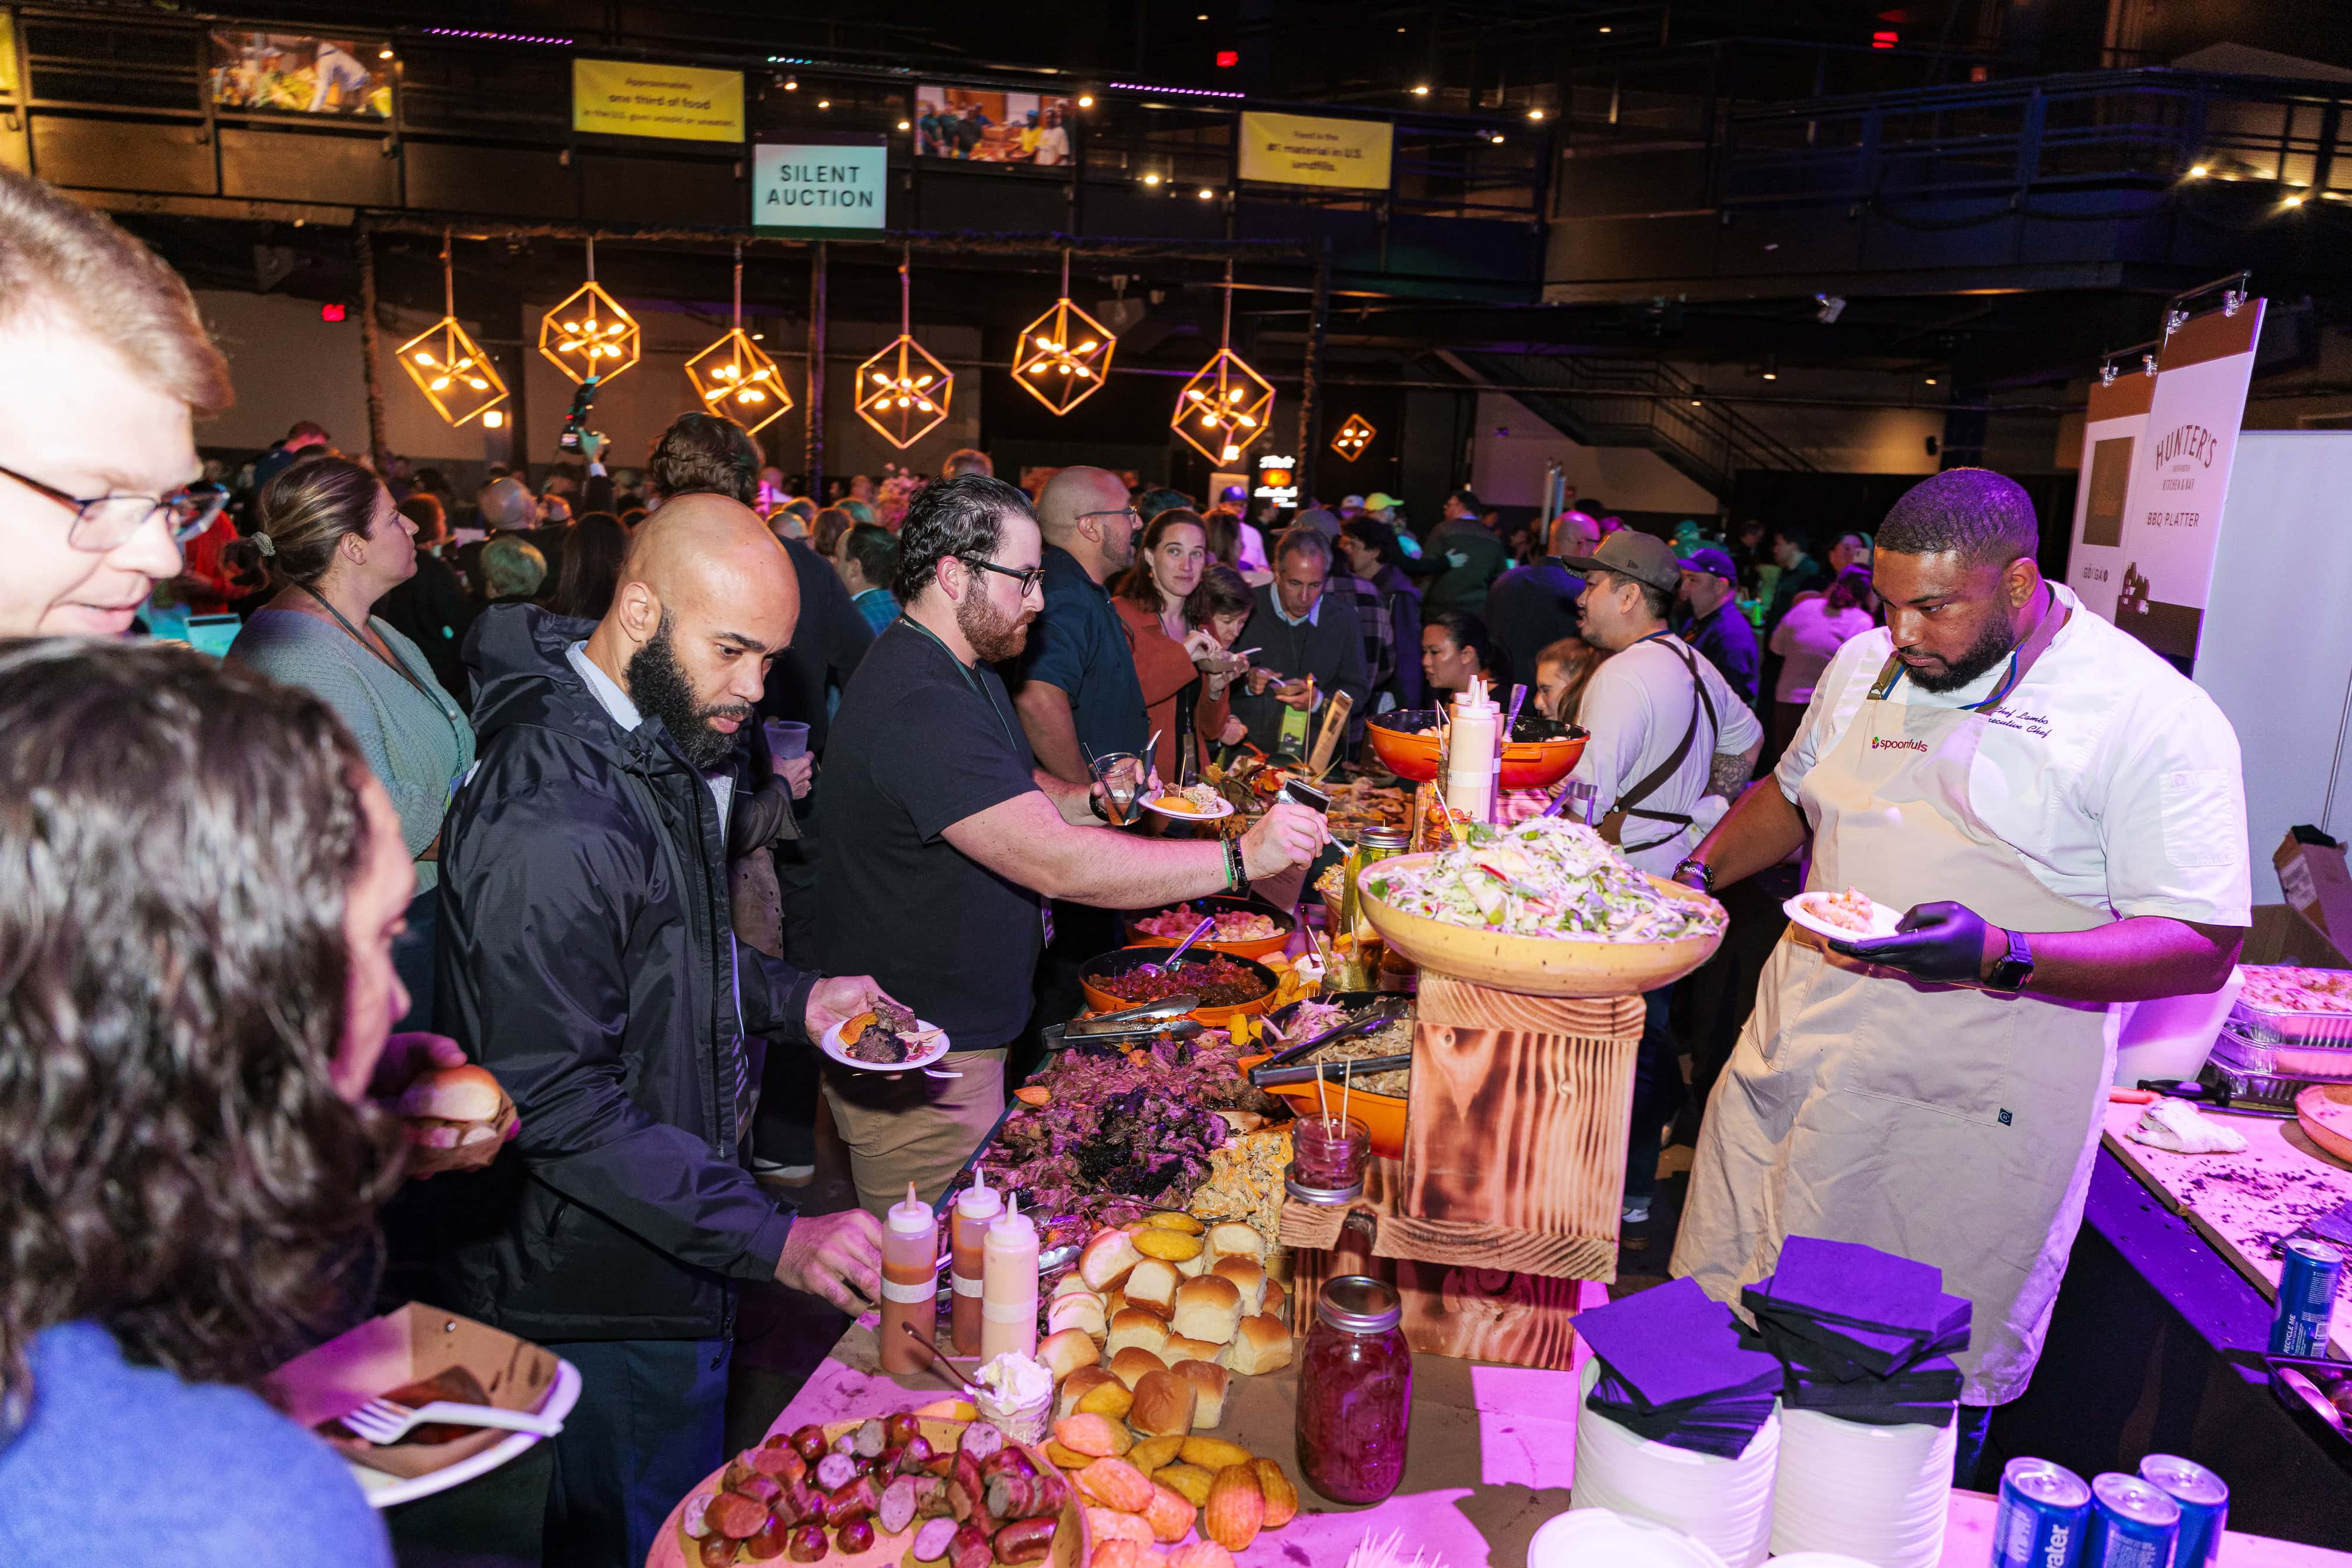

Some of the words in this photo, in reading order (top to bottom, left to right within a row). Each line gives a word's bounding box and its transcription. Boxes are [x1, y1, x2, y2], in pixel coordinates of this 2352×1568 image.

[781, 165, 860, 183] SILENT
[767, 189, 873, 207] AUCTION
[2156, 424, 2217, 470] HUNTER'S
[2147, 512, 2163, 528] BBQ
[2164, 512, 2199, 527] PLATTER
[2026, 725, 2052, 738] Chef
[2283, 1325, 2294, 1353] RECYCLE
[2290, 1314, 2296, 1325] ME
